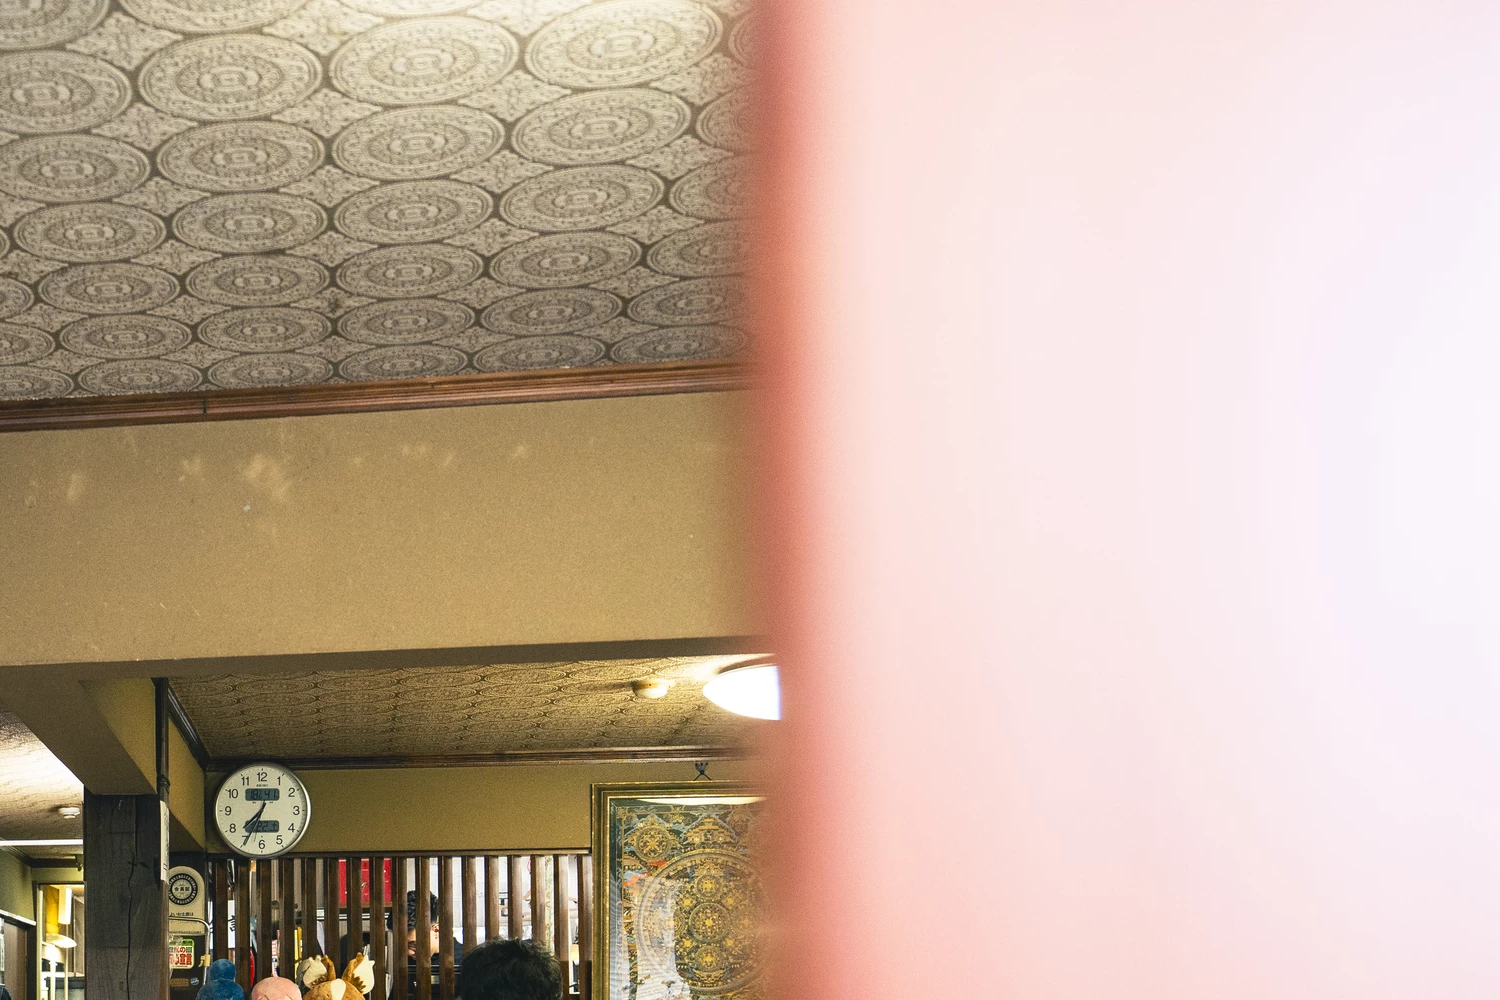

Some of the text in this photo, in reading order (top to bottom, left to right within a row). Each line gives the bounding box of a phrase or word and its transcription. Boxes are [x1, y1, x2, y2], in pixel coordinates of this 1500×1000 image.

[241, 776, 250, 786] 11
[256, 772, 268, 782] 12
[277, 776, 281, 786] 1
[228, 788, 239, 799] 10
[288, 787, 296, 798] 2
[224, 805, 232, 816] 9
[292, 805, 300, 816] 3
[229, 823, 237, 833] 8
[287, 823, 295, 833] 4
[258, 840, 266, 850] 6
[275, 835, 283, 845] 5
